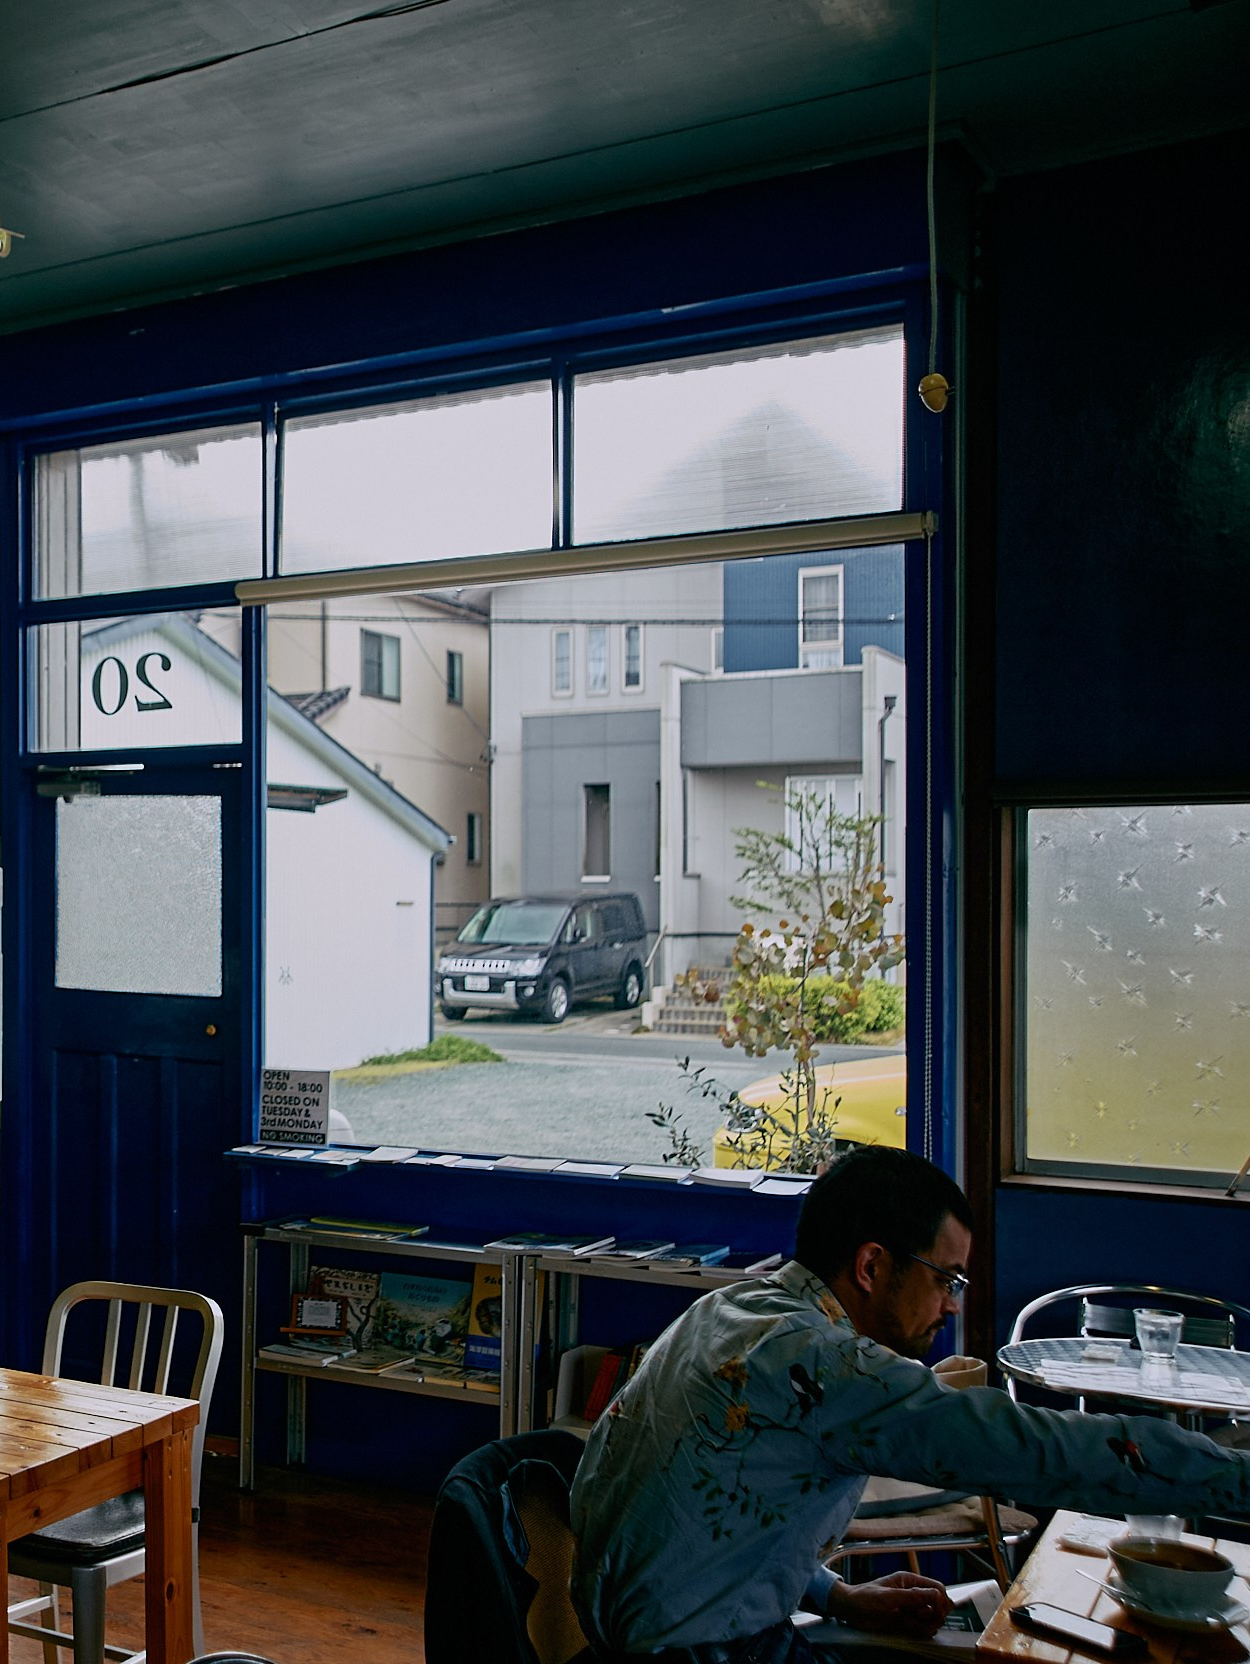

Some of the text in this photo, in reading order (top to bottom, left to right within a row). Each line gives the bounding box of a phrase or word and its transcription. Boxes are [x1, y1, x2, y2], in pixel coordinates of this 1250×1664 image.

[263, 1070, 290, 1080] OPEN
[264, 1081, 287, 1091] 10:00
[298, 1082, 323, 1093] 18:00
[262, 1094, 320, 1107] CLOSED ON
[262, 1105, 311, 1117] TUESDAY &
[277, 1118, 323, 1130] MONDAY
[262, 1130, 324, 1144] NO SMOKING
